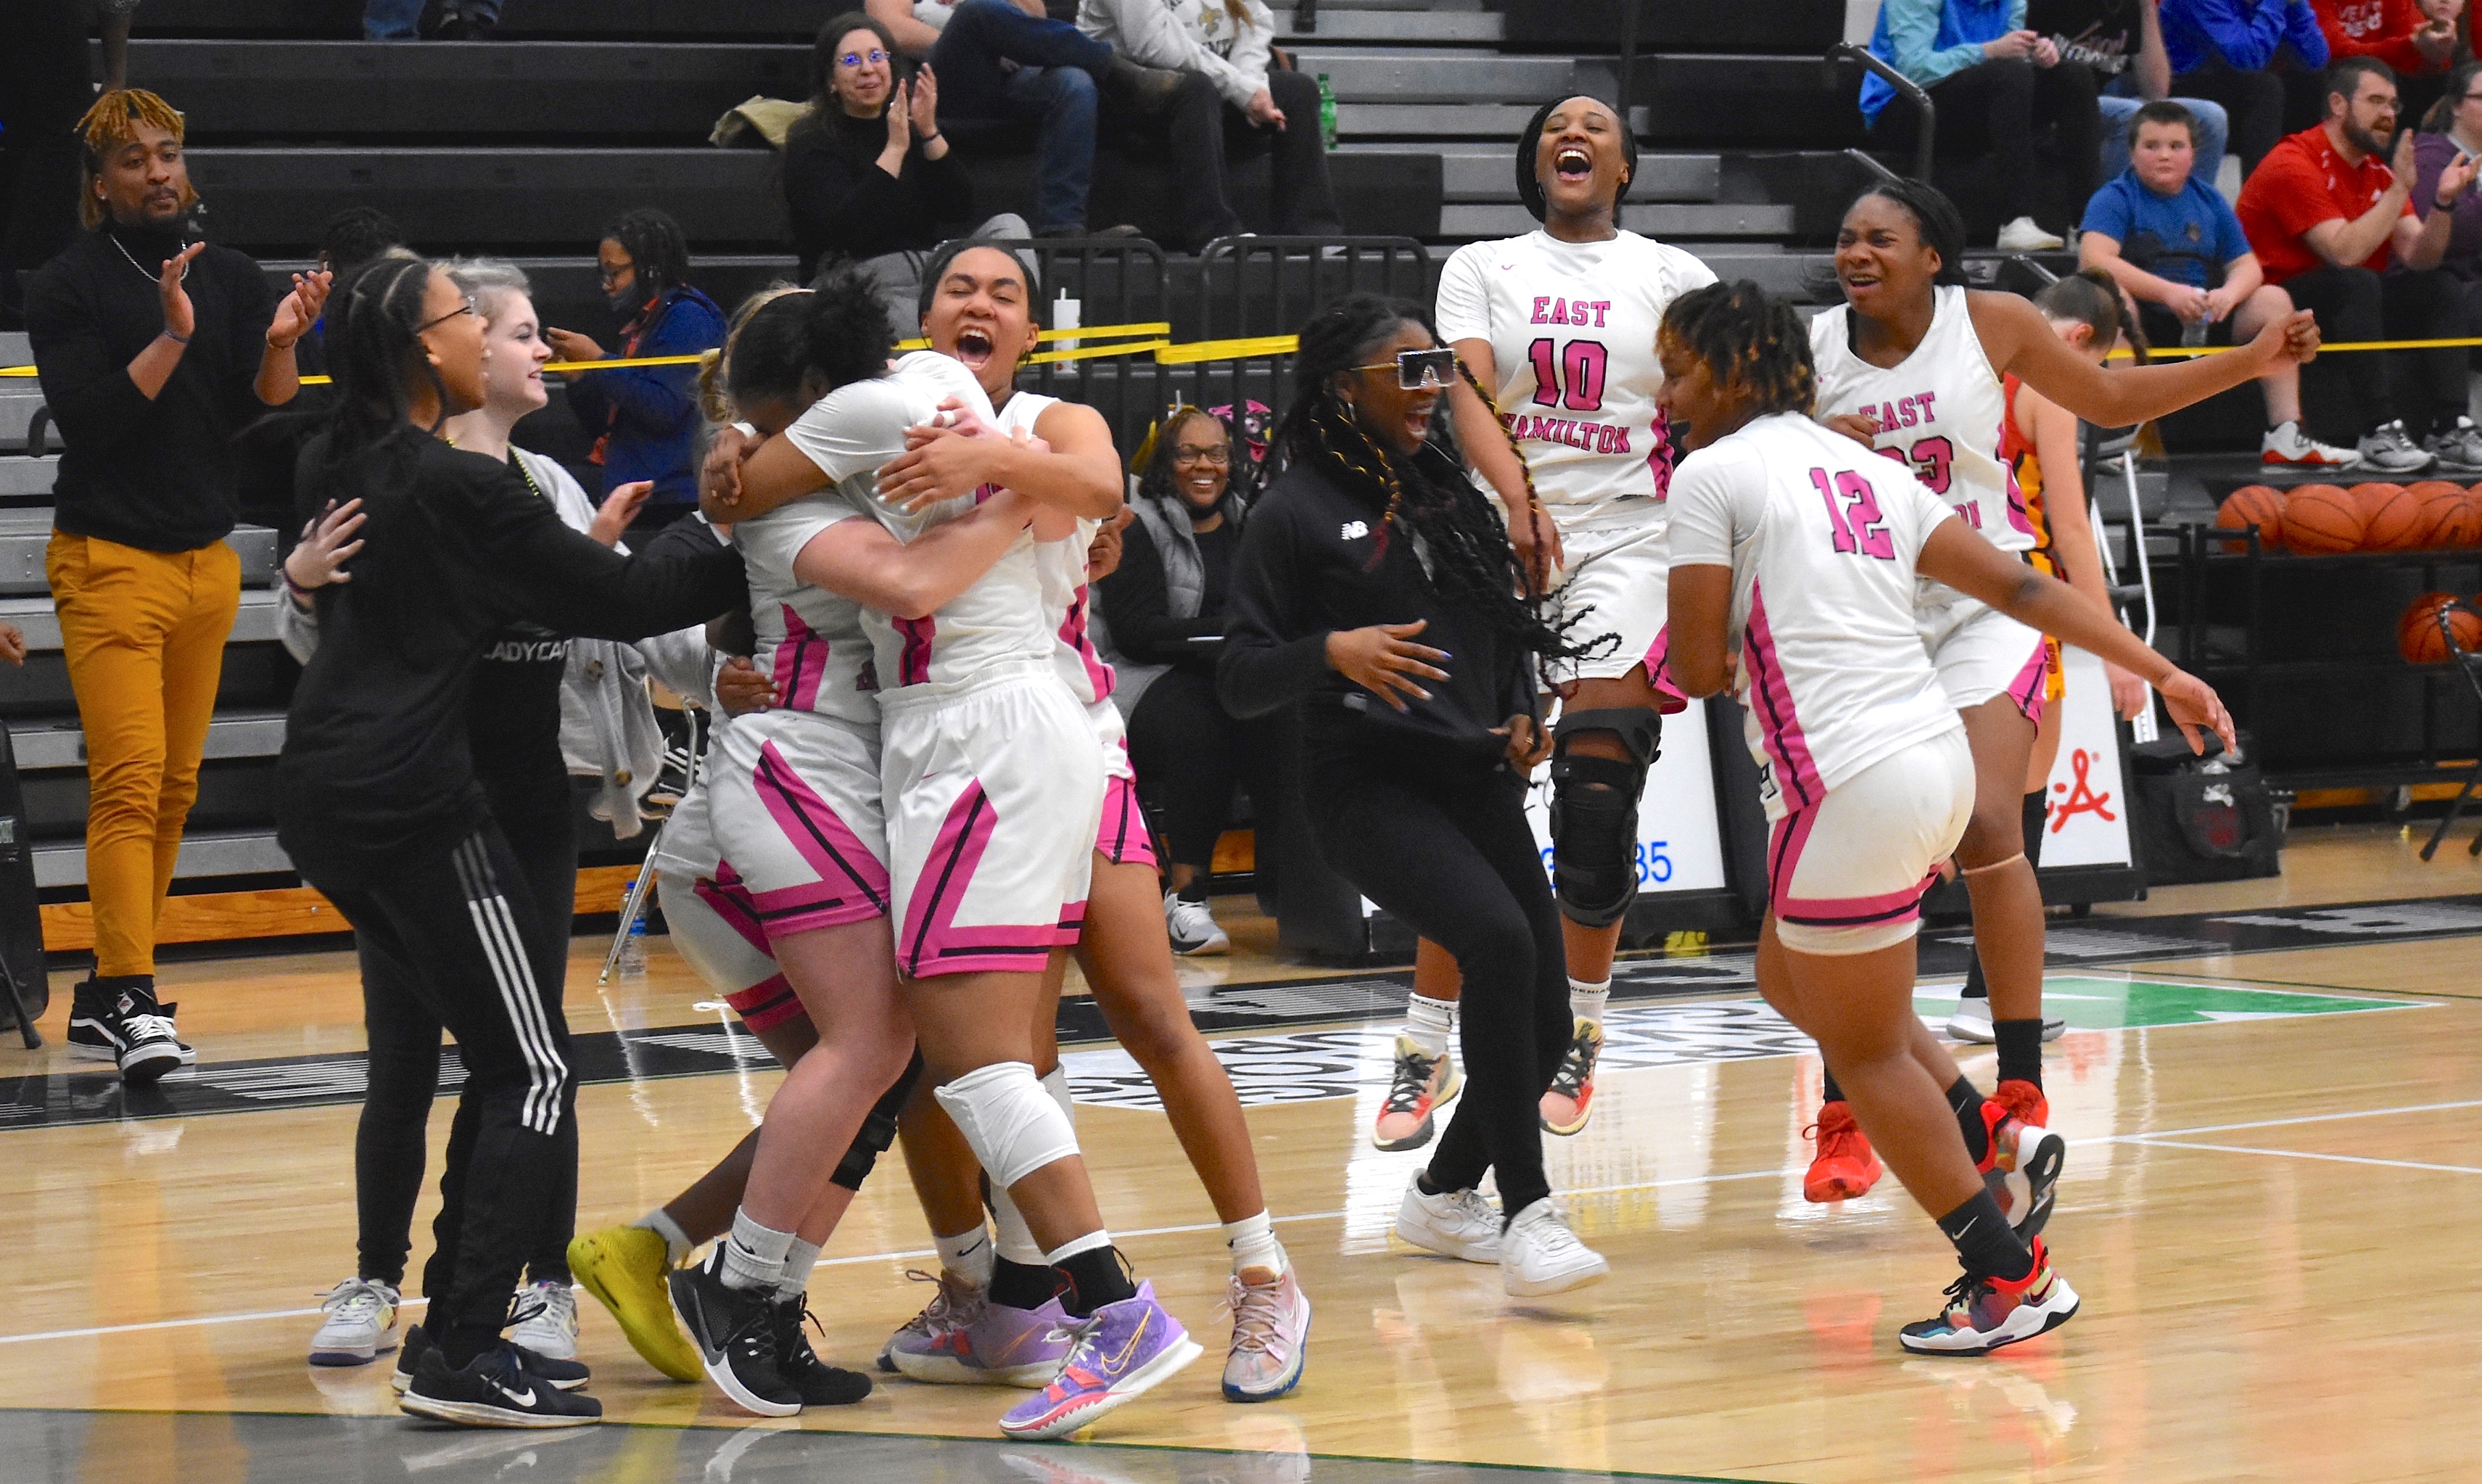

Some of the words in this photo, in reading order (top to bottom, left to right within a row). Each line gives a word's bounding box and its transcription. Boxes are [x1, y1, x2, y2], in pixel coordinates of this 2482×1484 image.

[1530, 296, 1611, 328] EAST
[1527, 337, 1608, 412] 10
[1873, 435, 1954, 495] 3
[1809, 468, 1896, 560] 12
